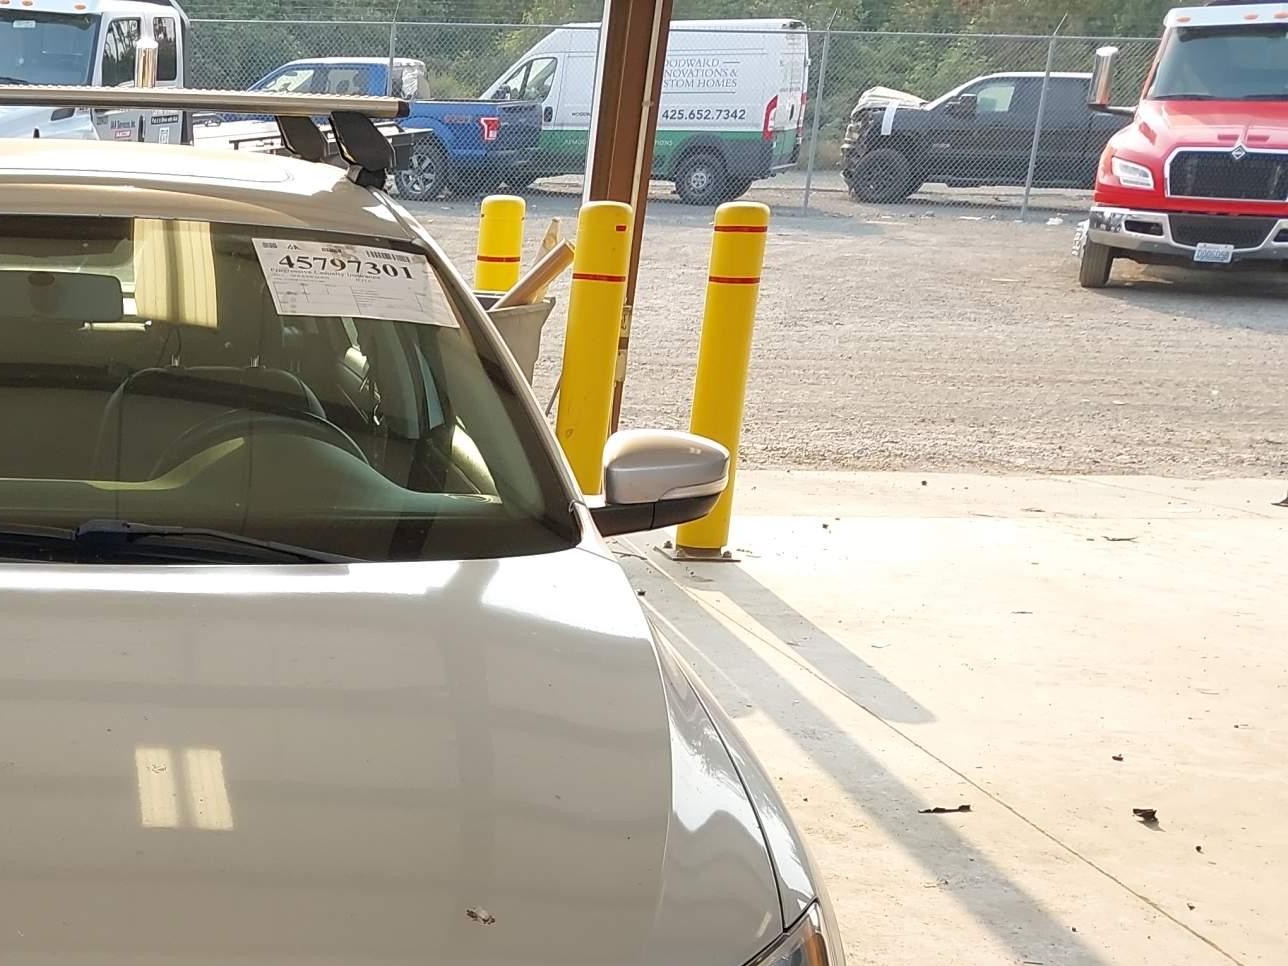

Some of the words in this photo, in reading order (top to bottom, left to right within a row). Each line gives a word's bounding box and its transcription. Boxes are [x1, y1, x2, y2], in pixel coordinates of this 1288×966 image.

[665, 58, 720, 68] ODWARD
[664, 68, 727, 78] NOVATIONS
[663, 79, 694, 88] STOM
[697, 79, 737, 88] HOMES
[662, 109, 746, 120] 425.652.7342
[278, 254, 415, 280] 45797301
